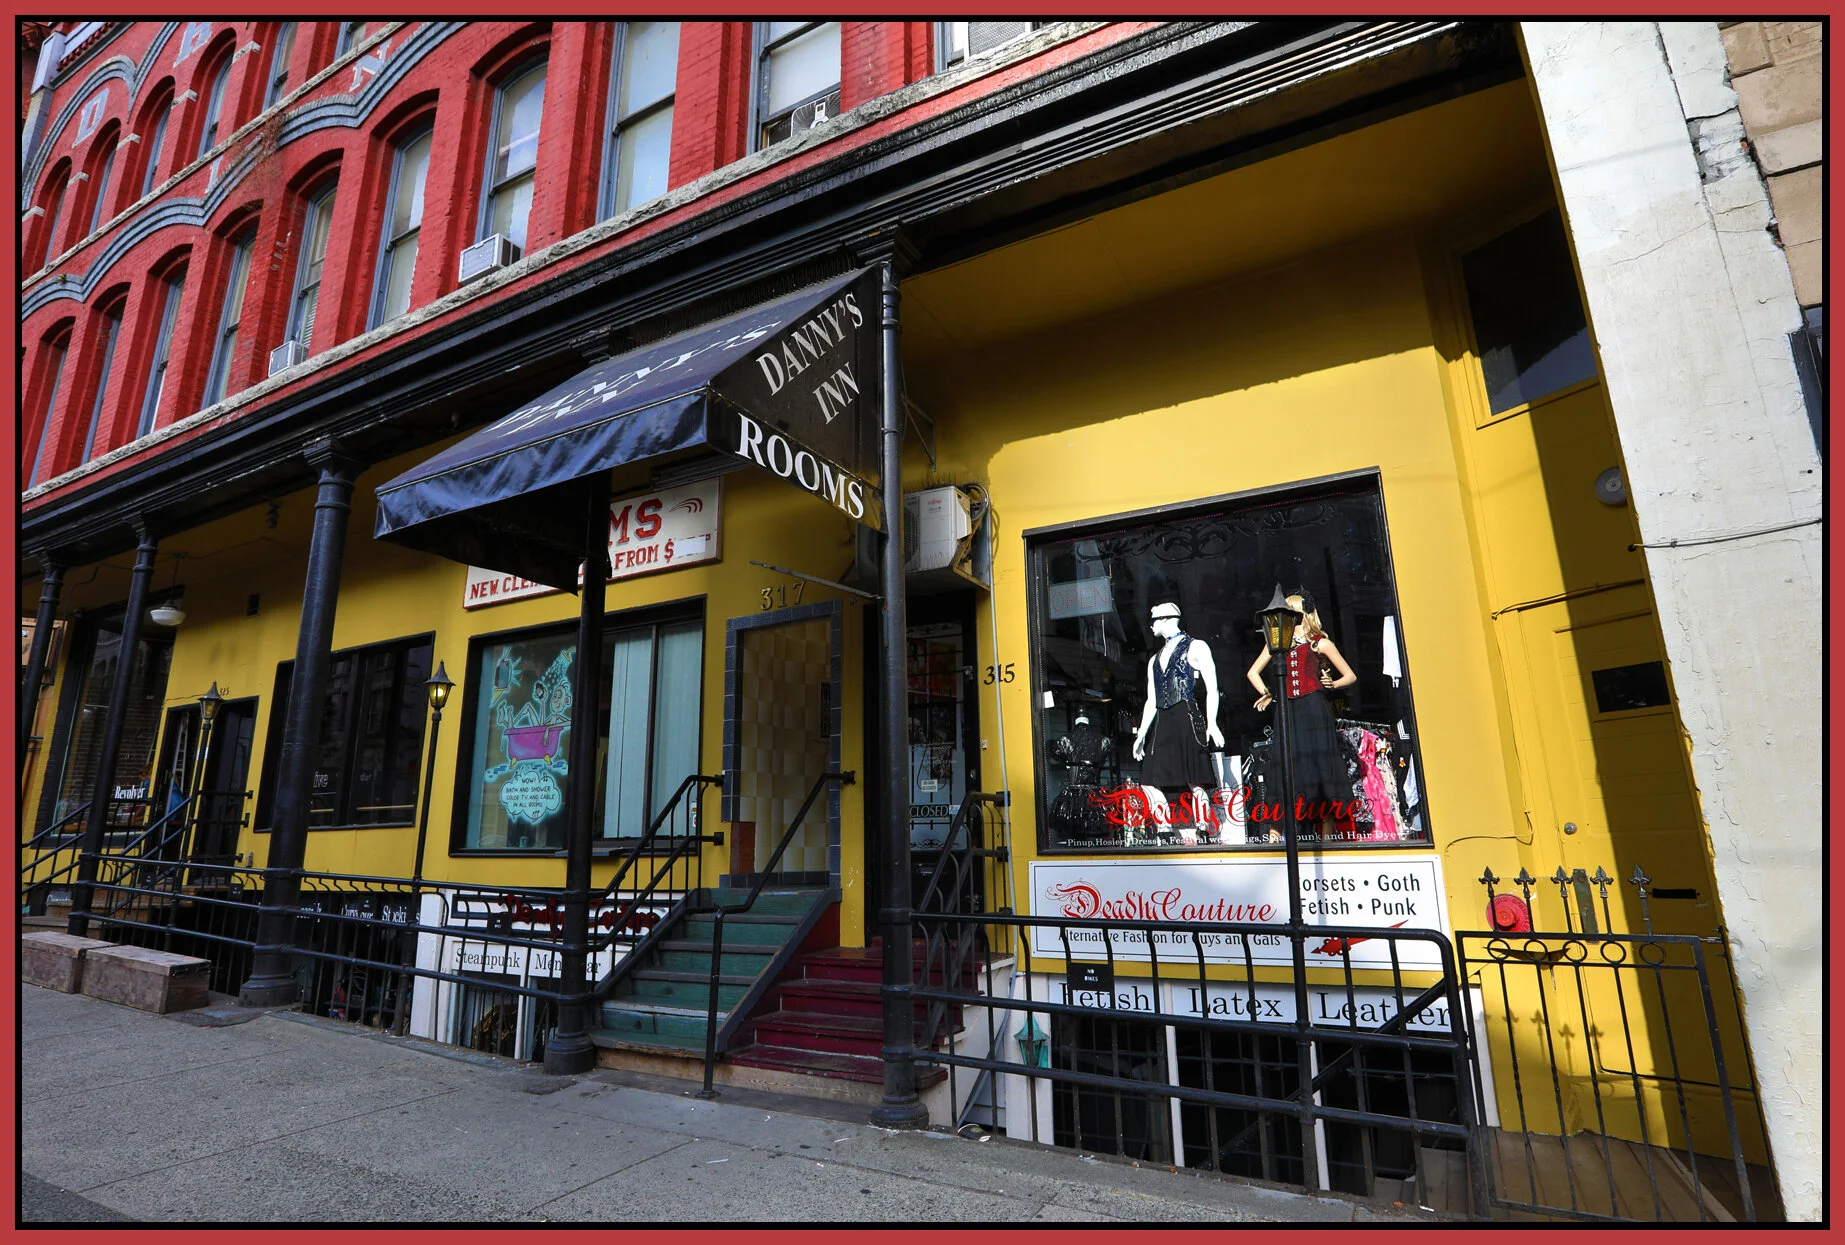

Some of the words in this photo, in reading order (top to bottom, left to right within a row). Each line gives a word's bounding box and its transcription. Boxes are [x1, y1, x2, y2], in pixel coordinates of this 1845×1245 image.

[756, 291, 863, 396] DANNY'S
[813, 362, 861, 425] INN
[734, 412, 864, 519] ROOMS
[614, 544, 659, 571] FROM
[760, 581, 807, 610] 317
[1051, 584, 1109, 613] OPEN
[983, 663, 1015, 685] 315
[114, 785, 146, 800] Revolver
[909, 805, 950, 818] CLOSED
[1087, 784, 1222, 835] Deadly
[1131, 836, 1169, 848] Dresss,
[1324, 831, 1343, 840] and
[1347, 830, 1372, 840] Hair
[1375, 828, 1397, 840] Dye
[1299, 876, 1356, 892] orsets
[1378, 873, 1421, 892] Goth
[1045, 878, 1158, 921] Deadly
[1151, 888, 1278, 921] Couture
[1371, 897, 1417, 916] Punk
[1123, 930, 1168, 945] Fashon
[1171, 930, 1188, 944] for
[1191, 932, 1221, 947] uys
[1252, 933, 1281, 946] Gals
